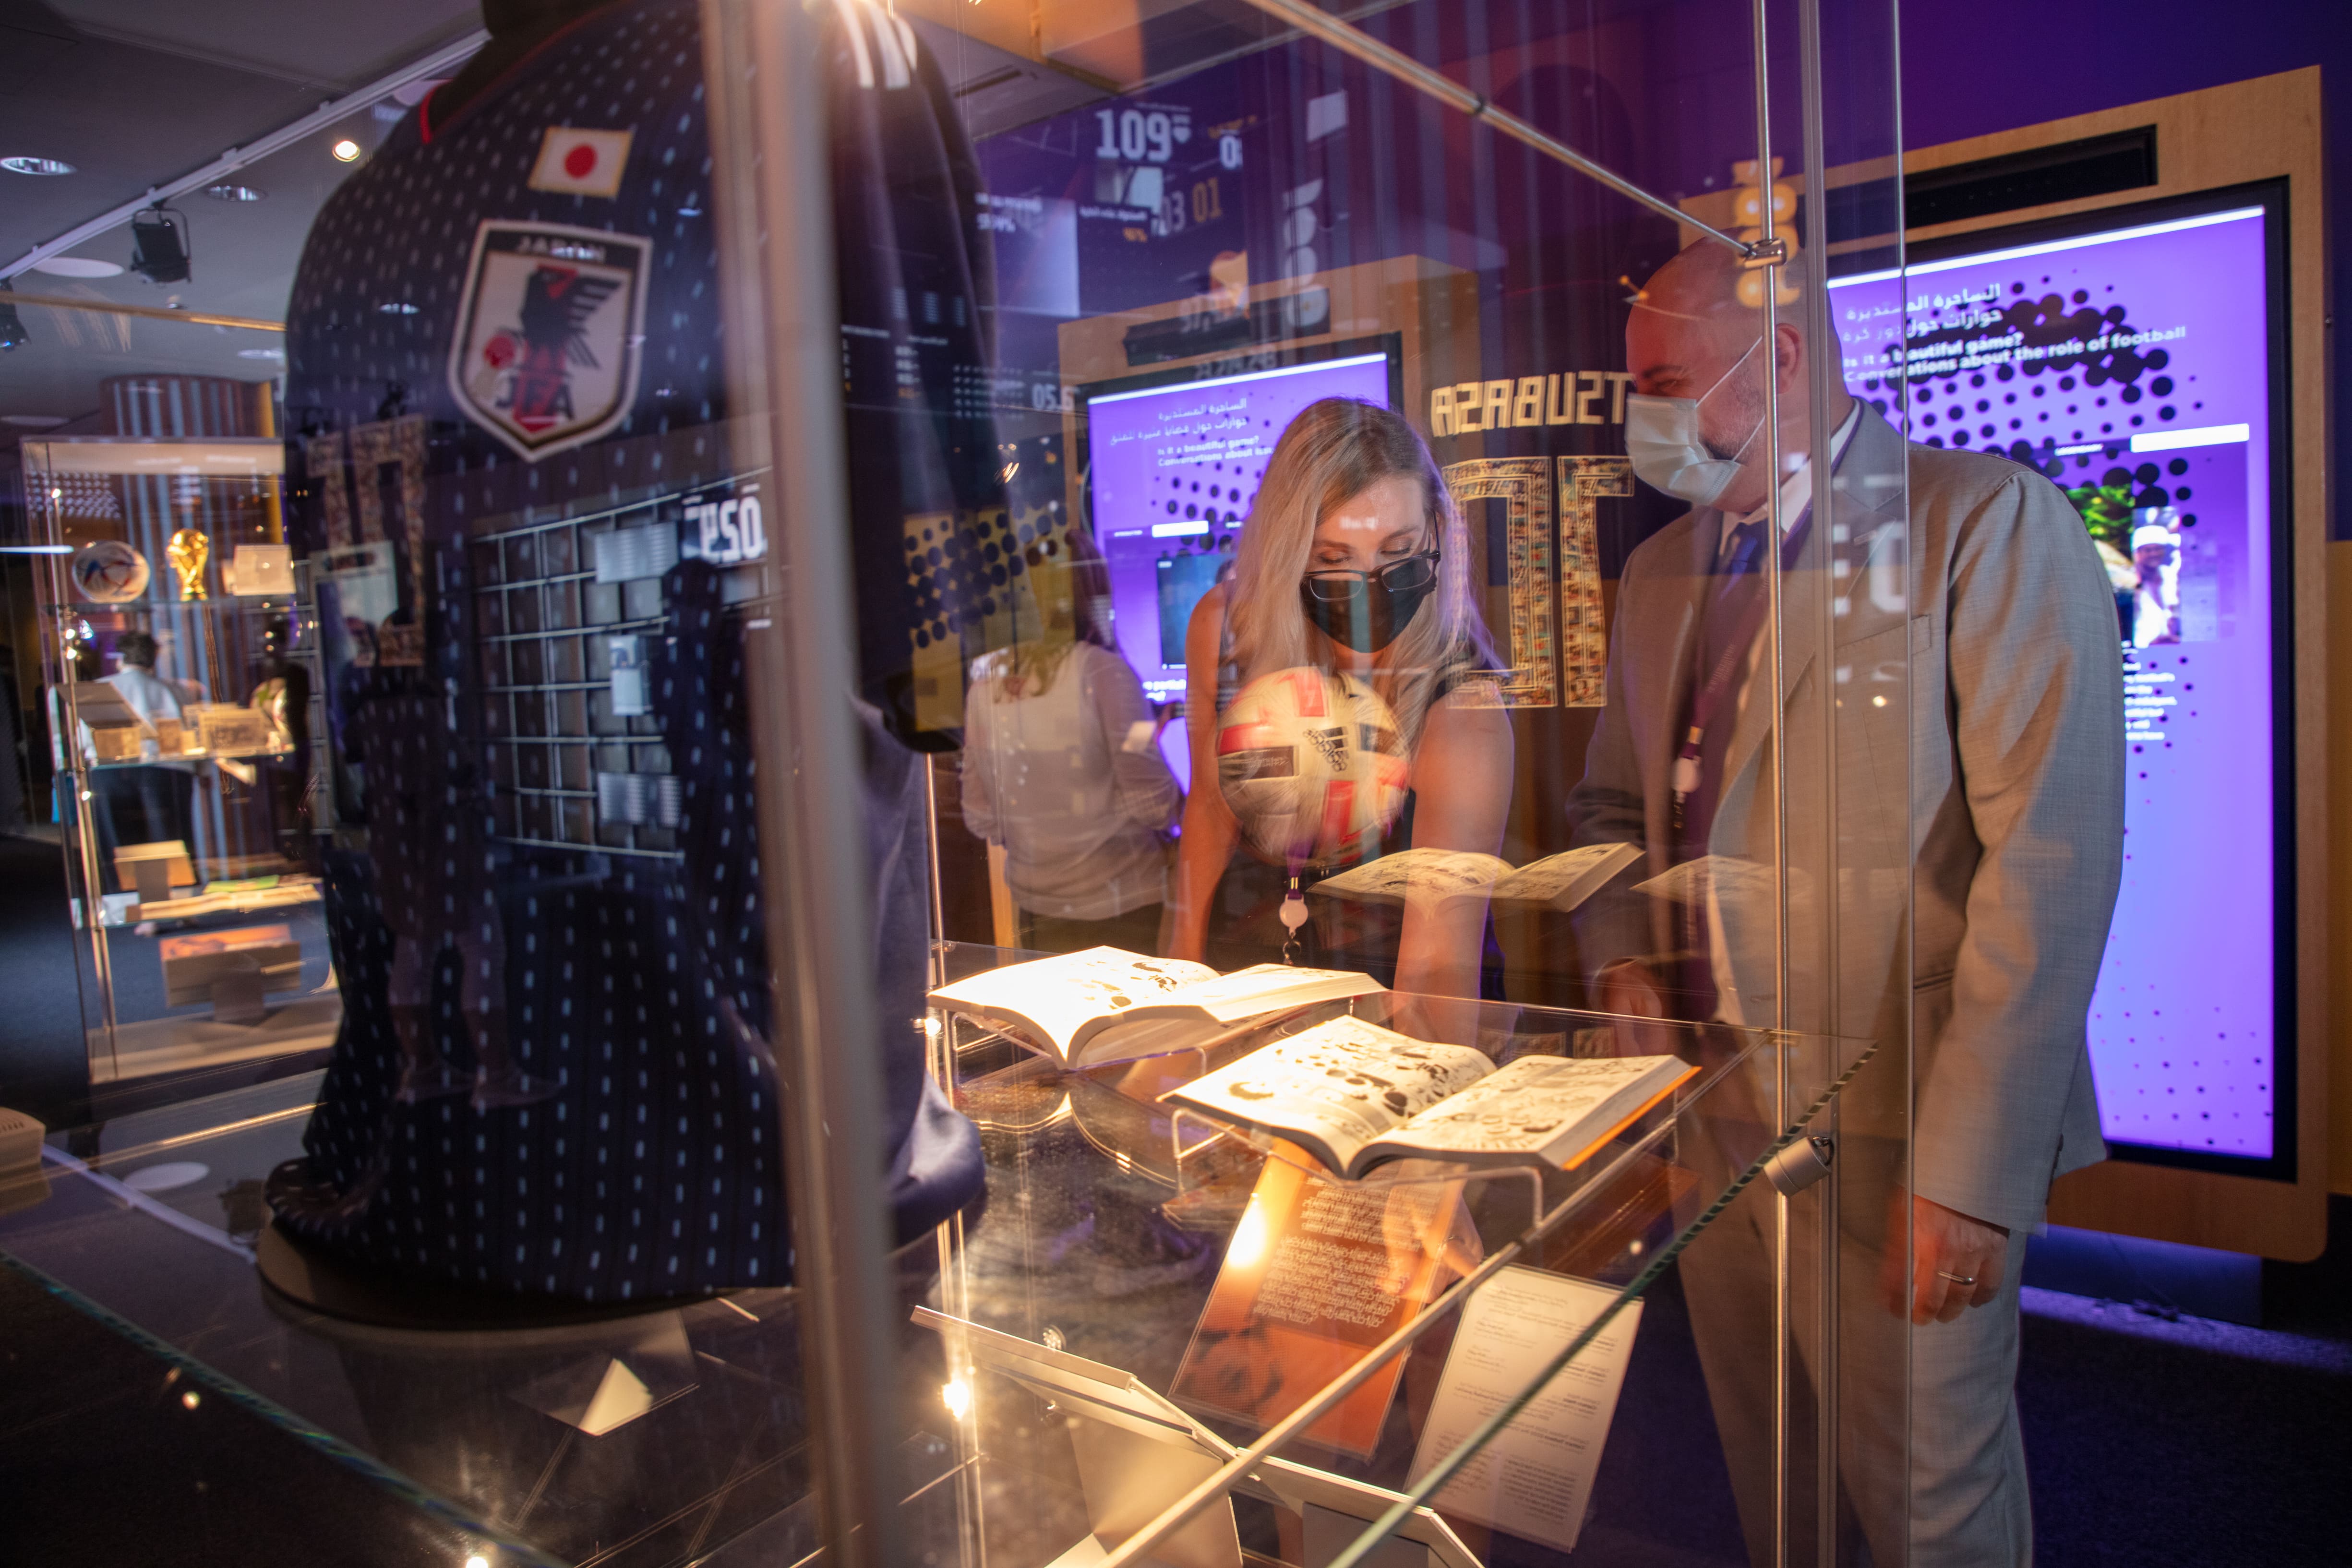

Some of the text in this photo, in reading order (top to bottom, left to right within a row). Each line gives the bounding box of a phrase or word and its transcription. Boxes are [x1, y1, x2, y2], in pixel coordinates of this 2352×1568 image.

[1095, 108, 1172, 163] 109
[1844, 326, 2186, 382] Converations about the role of football
[1892, 339, 1964, 363] bautiful
[1965, 331, 2025, 356] game?
